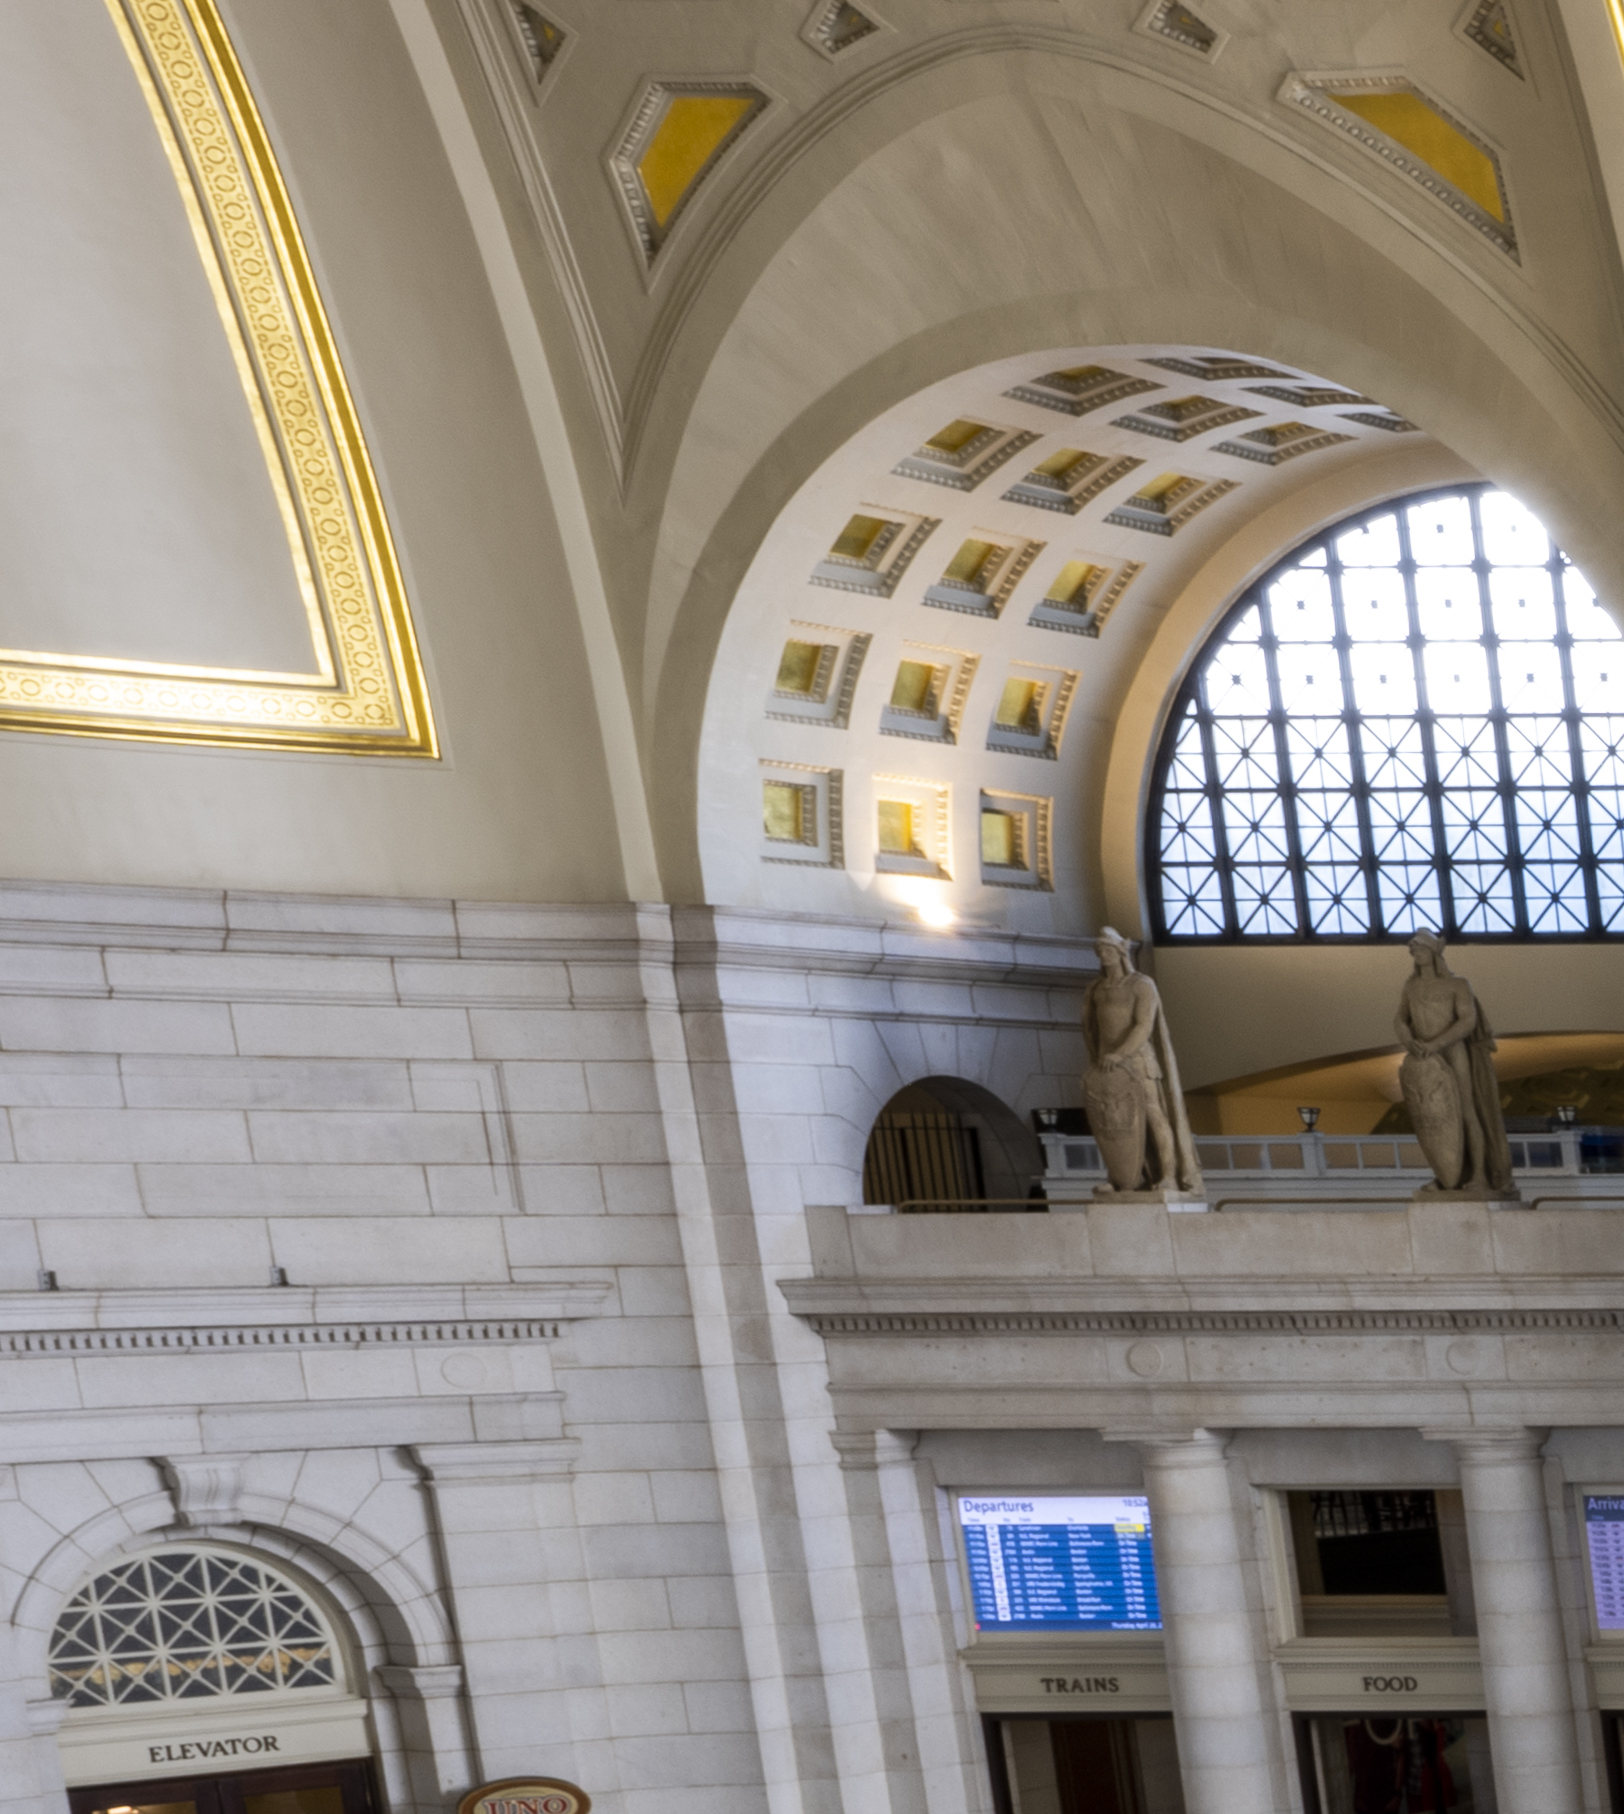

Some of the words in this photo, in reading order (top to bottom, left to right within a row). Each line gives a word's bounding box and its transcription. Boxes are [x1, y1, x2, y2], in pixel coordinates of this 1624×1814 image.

[963, 1500, 1034, 1515] Departures
[1040, 1676, 1121, 1696] TRAINS
[1361, 1674, 1418, 1694] FOOD
[148, 1734, 280, 1764] ELEVATOR
